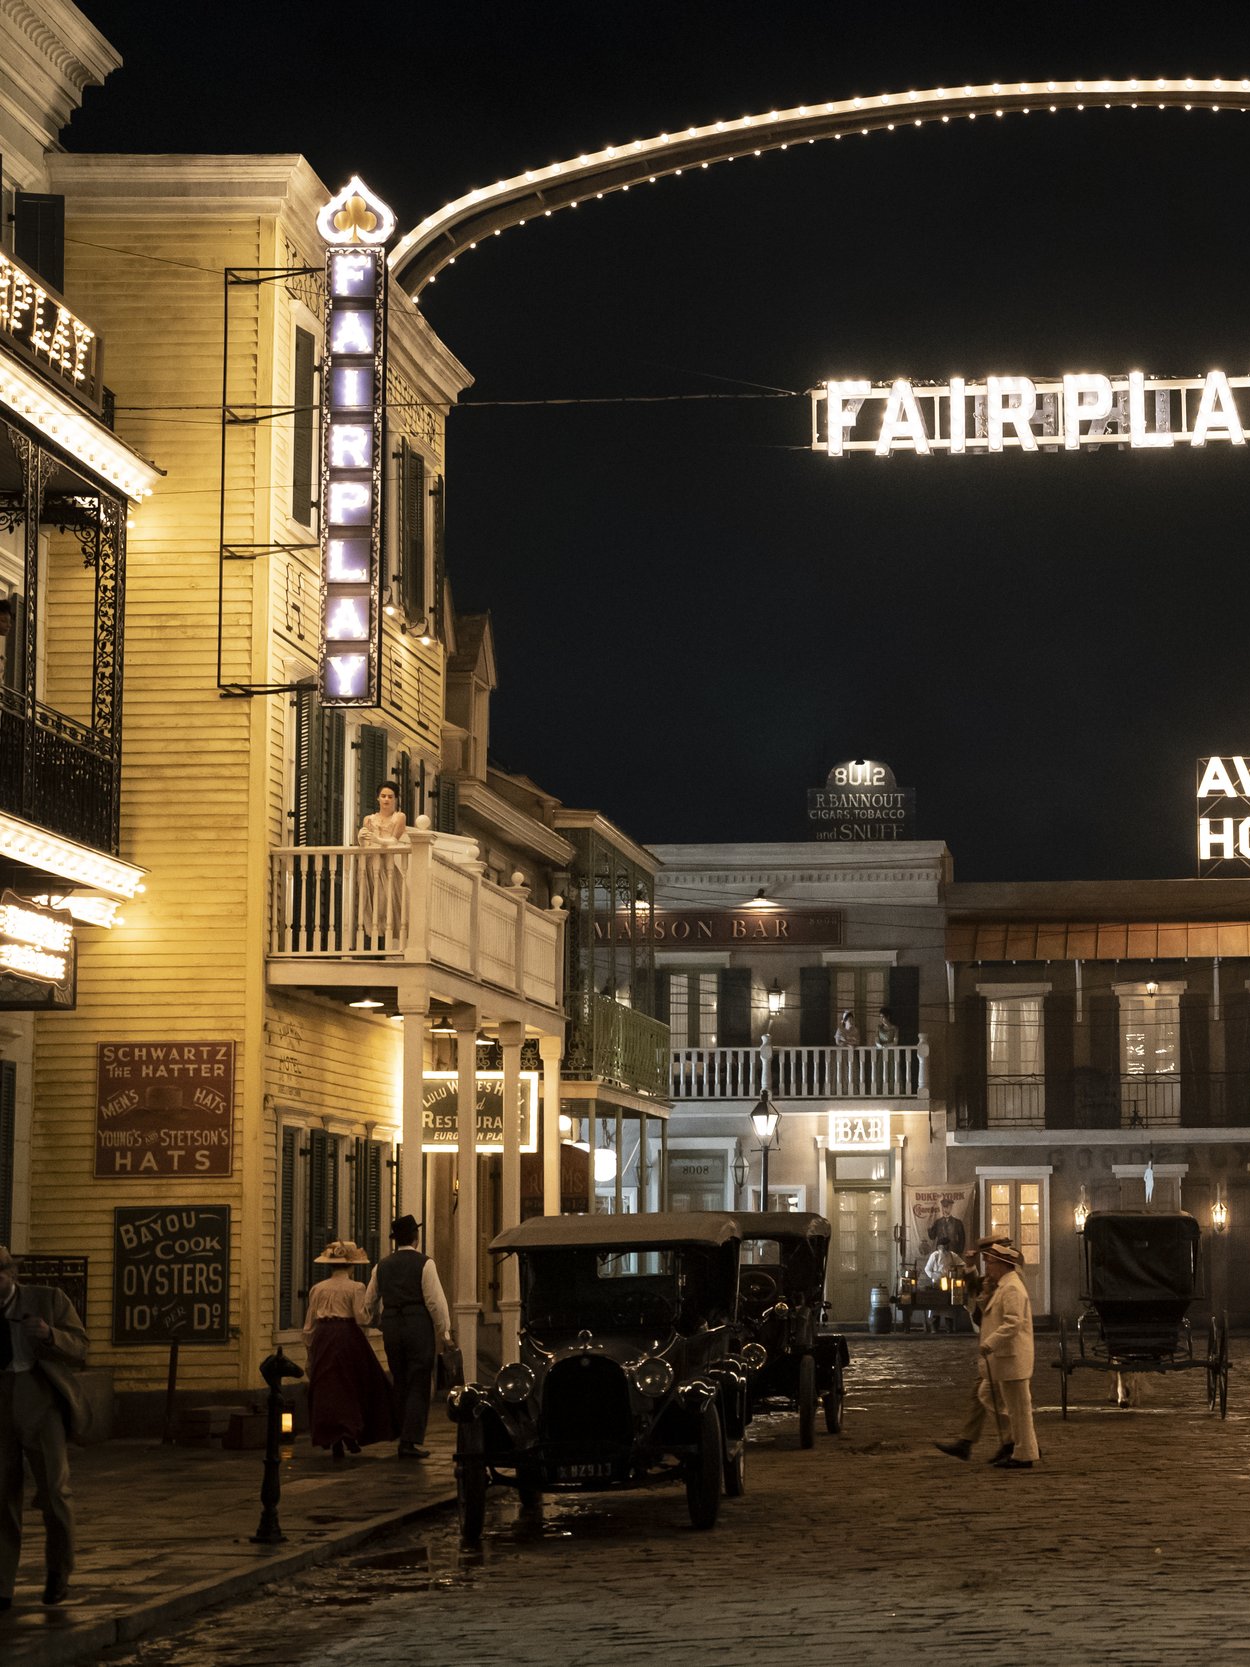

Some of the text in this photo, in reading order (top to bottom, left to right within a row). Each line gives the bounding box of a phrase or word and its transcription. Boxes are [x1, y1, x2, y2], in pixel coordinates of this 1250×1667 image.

[330, 255, 372, 698] FAIRPLAY
[829, 794, 905, 808] BANNOUT
[853, 810, 905, 819] TOBACCO
[816, 824, 905, 842] and SNUFF
[731, 919, 790, 939] BAR
[103, 1046, 228, 1062] SCHWARTZ
[141, 1063, 226, 1079] HATTER
[101, 1087, 228, 1120] MEN'S HATS
[98, 1128, 143, 1148] YOUNG'S
[160, 1128, 229, 1147] STETSON'S
[433, 1131, 484, 1141] EURON
[836, 1117, 885, 1142] BAR
[114, 1150, 211, 1171] HATS
[682, 1165, 709, 1175] 8008
[119, 1211, 197, 1250] BAYOU
[155, 1236, 223, 1260] COOK
[123, 1263, 223, 1295] OYSTERS
